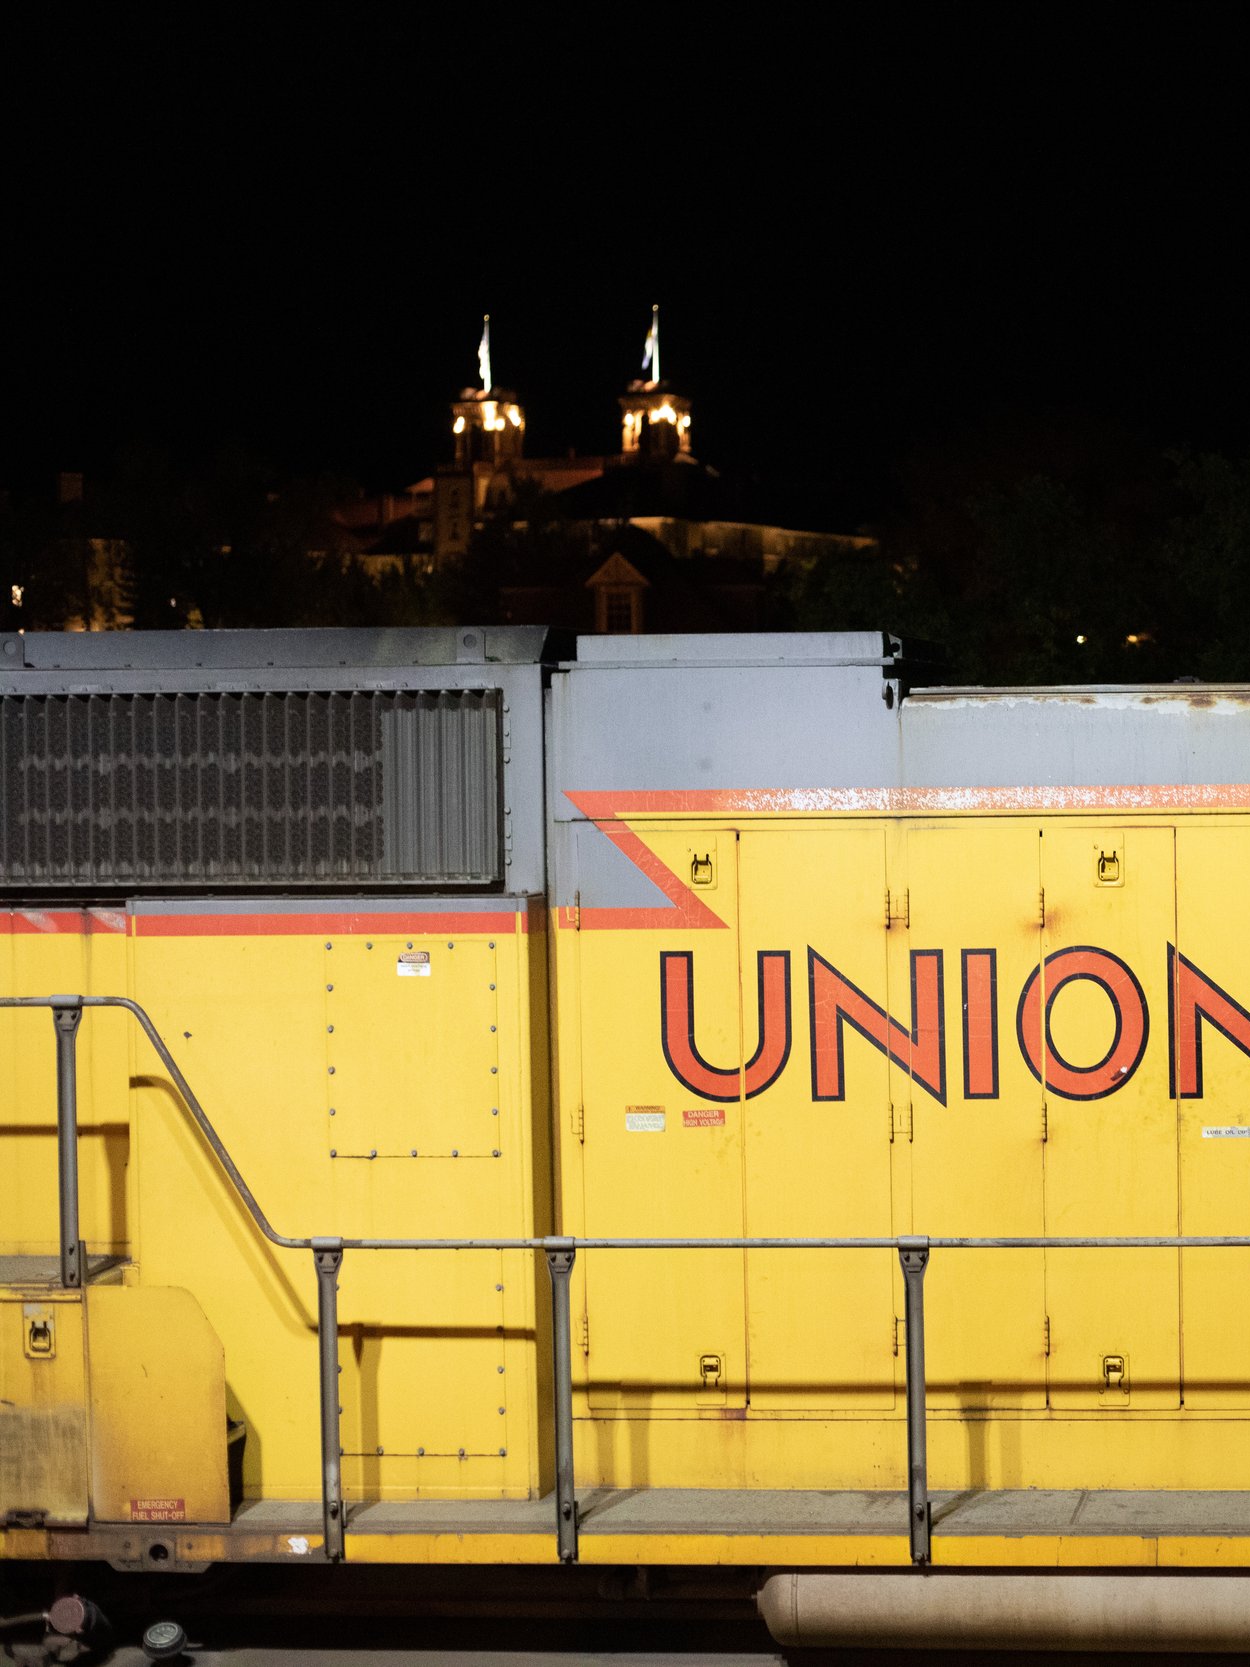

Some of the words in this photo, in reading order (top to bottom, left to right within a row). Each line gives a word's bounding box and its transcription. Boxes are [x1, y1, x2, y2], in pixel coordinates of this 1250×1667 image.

[687, 1110, 720, 1118] DANGER
[684, 1118, 698, 1127] HIGH
[700, 1118, 724, 1126] VOLTAGE
[137, 1500, 178, 1510] EMERGENCY
[132, 1511, 149, 1520] FUEL
[150, 1511, 185, 1520] SHUT-OFF
